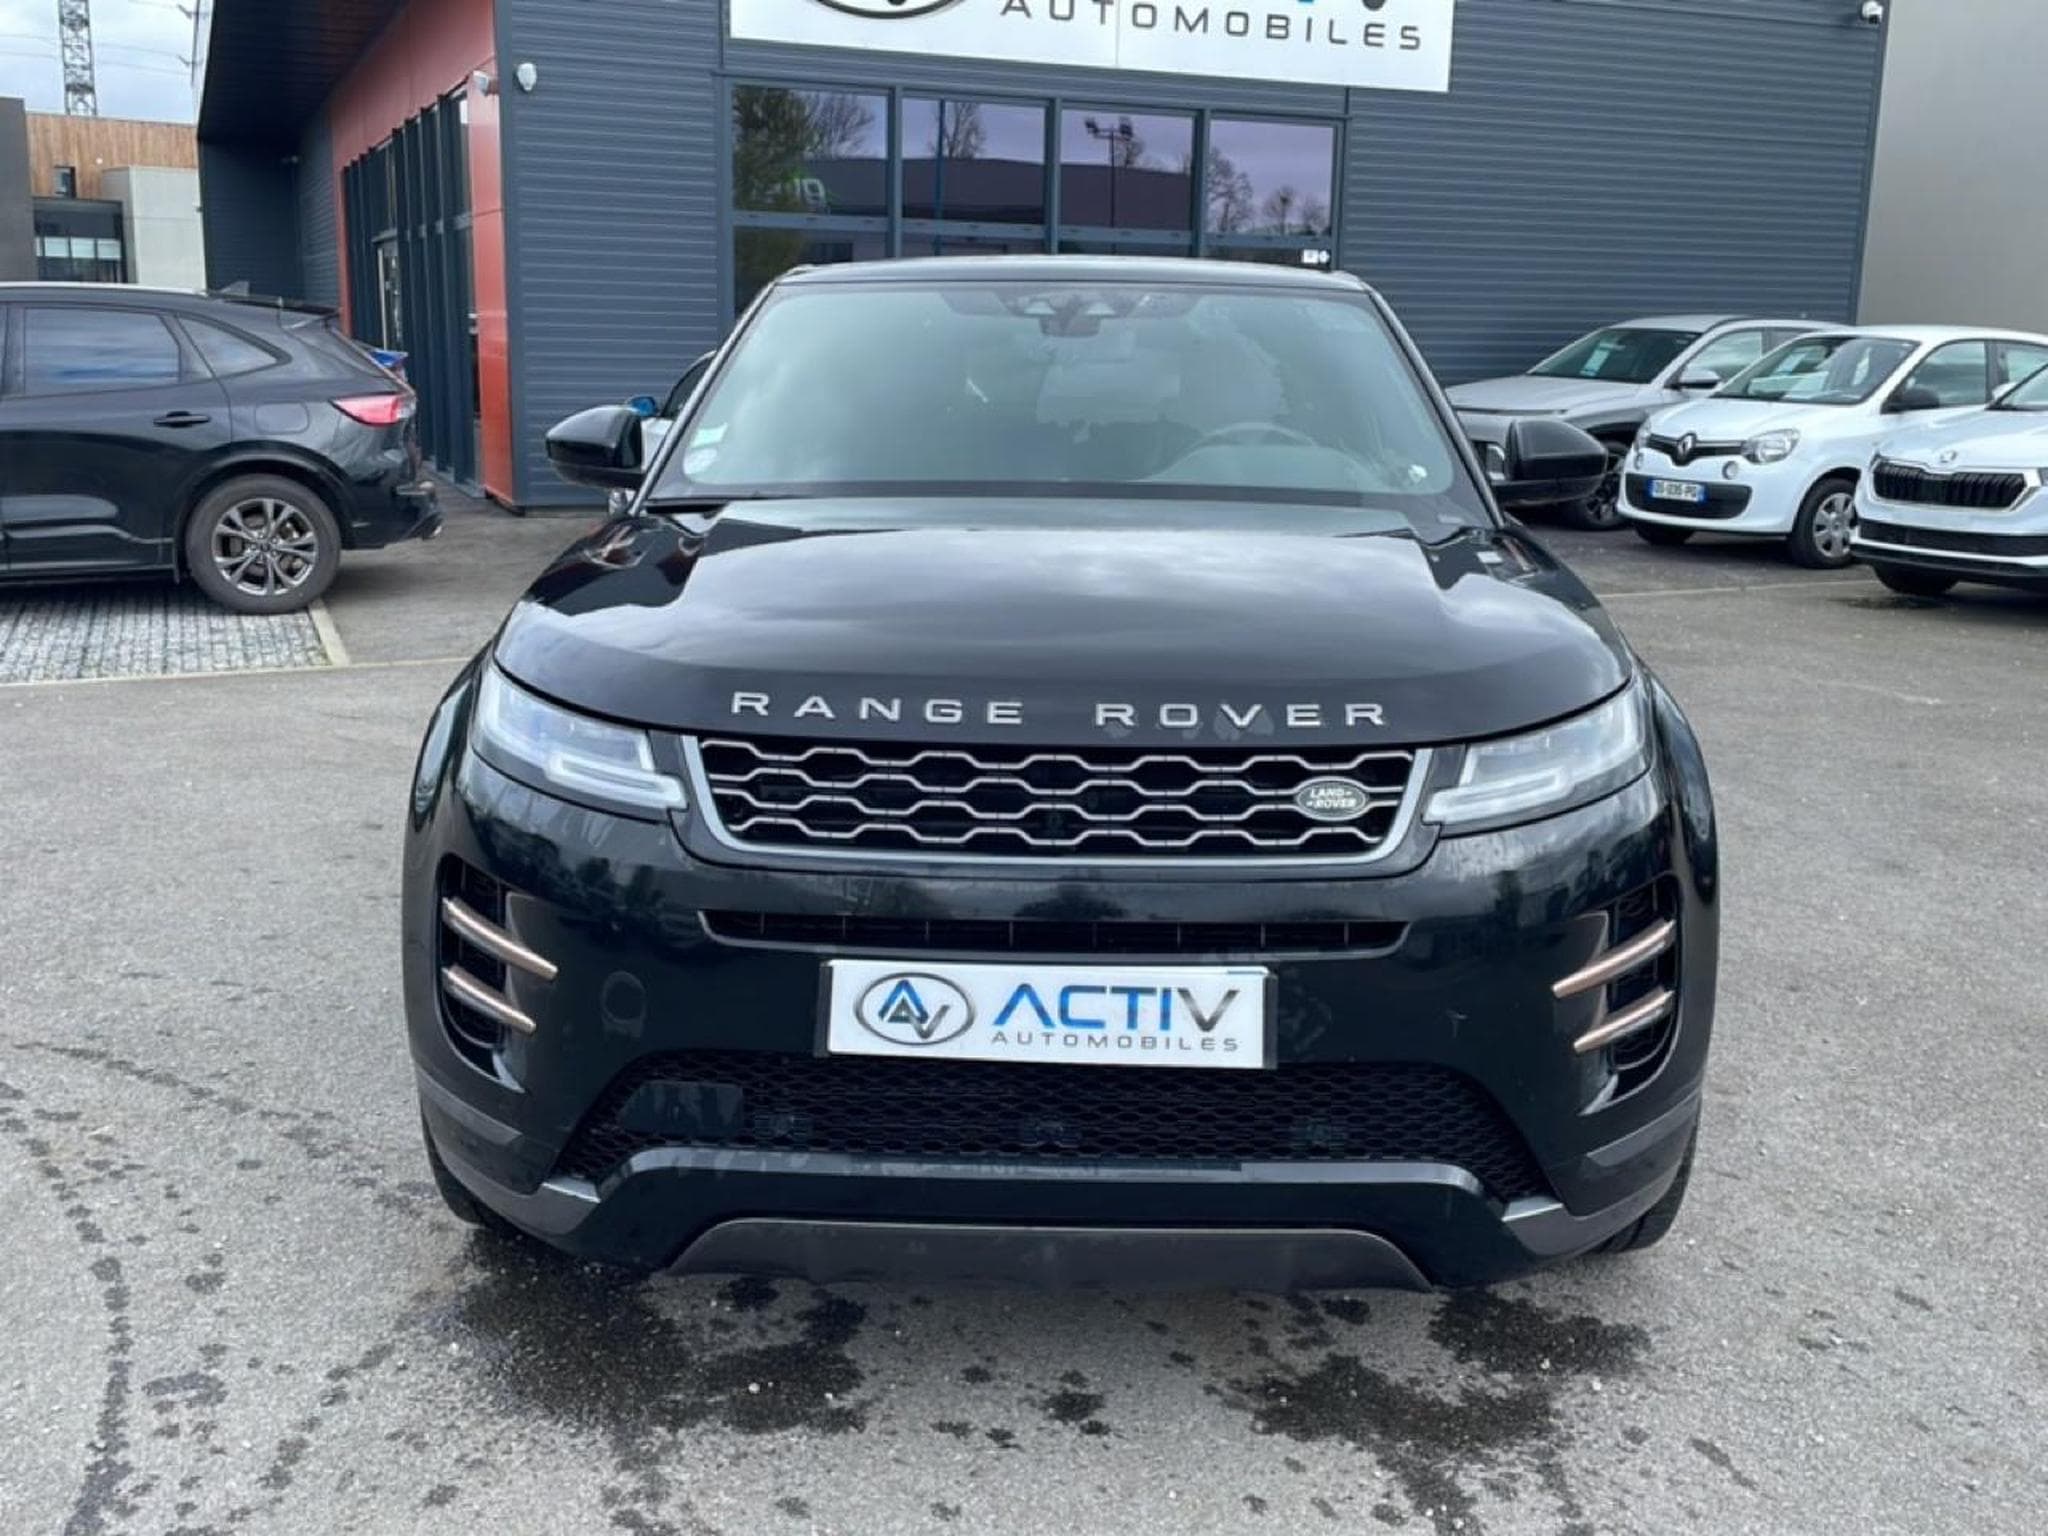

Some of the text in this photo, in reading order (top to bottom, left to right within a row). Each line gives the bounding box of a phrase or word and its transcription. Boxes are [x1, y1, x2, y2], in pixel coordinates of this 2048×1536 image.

[1000, 0, 1421, 50] AUTOMOBILES
[731, 692, 1385, 728] RANGE ROVER
[993, 983, 1241, 1032] ACTIV
[991, 1030, 1239, 1052] AUTOMOBILES
